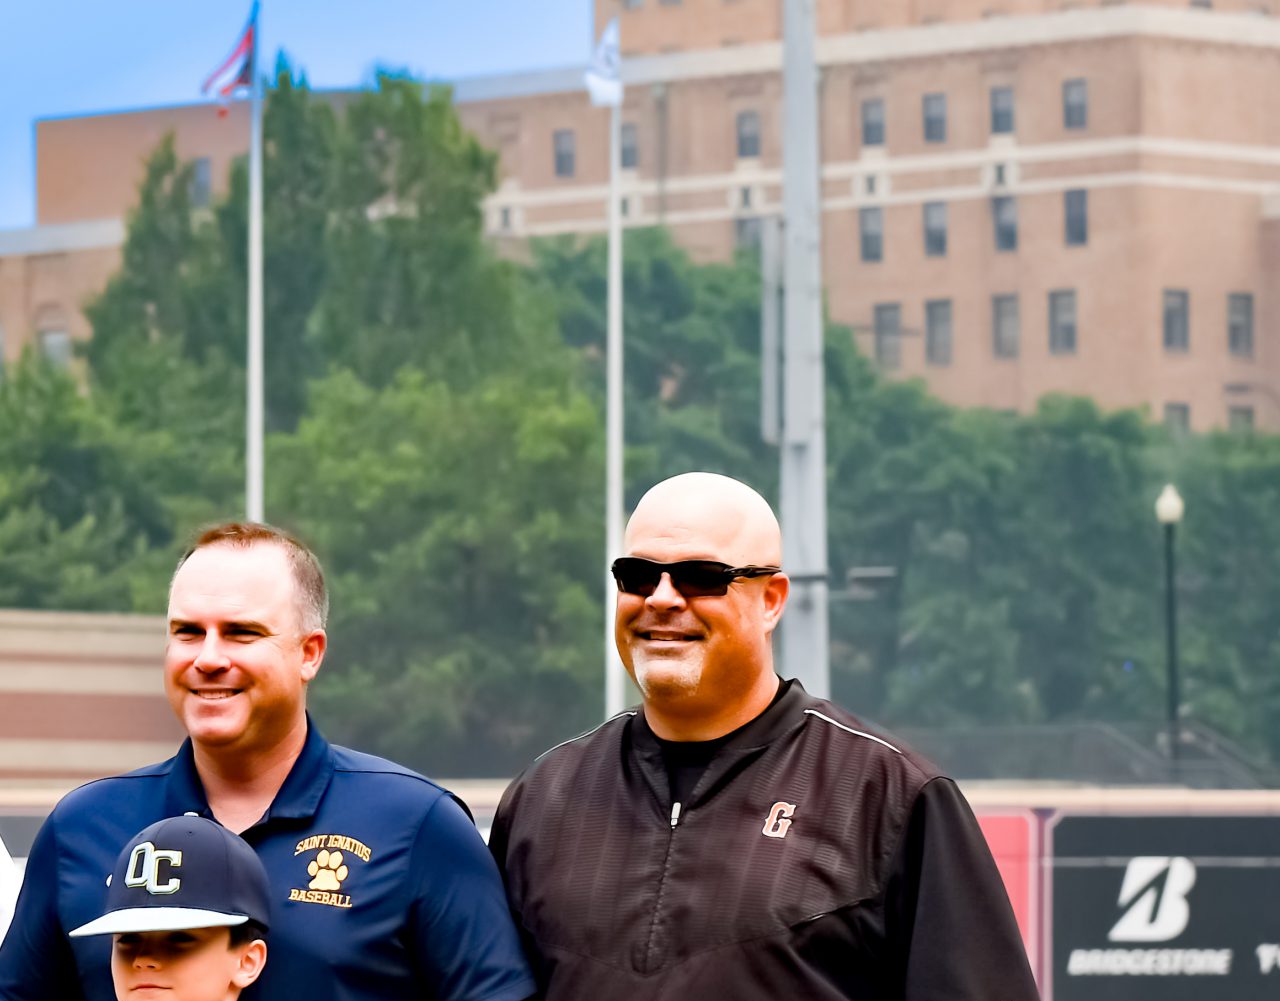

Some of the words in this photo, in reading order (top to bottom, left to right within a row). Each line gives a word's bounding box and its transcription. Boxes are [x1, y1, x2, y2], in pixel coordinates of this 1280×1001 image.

[762, 801, 797, 838] G
[294, 835, 328, 856] SAINT
[327, 835, 372, 862] IGNATIUS
[288, 889, 352, 907] BASEBALL
